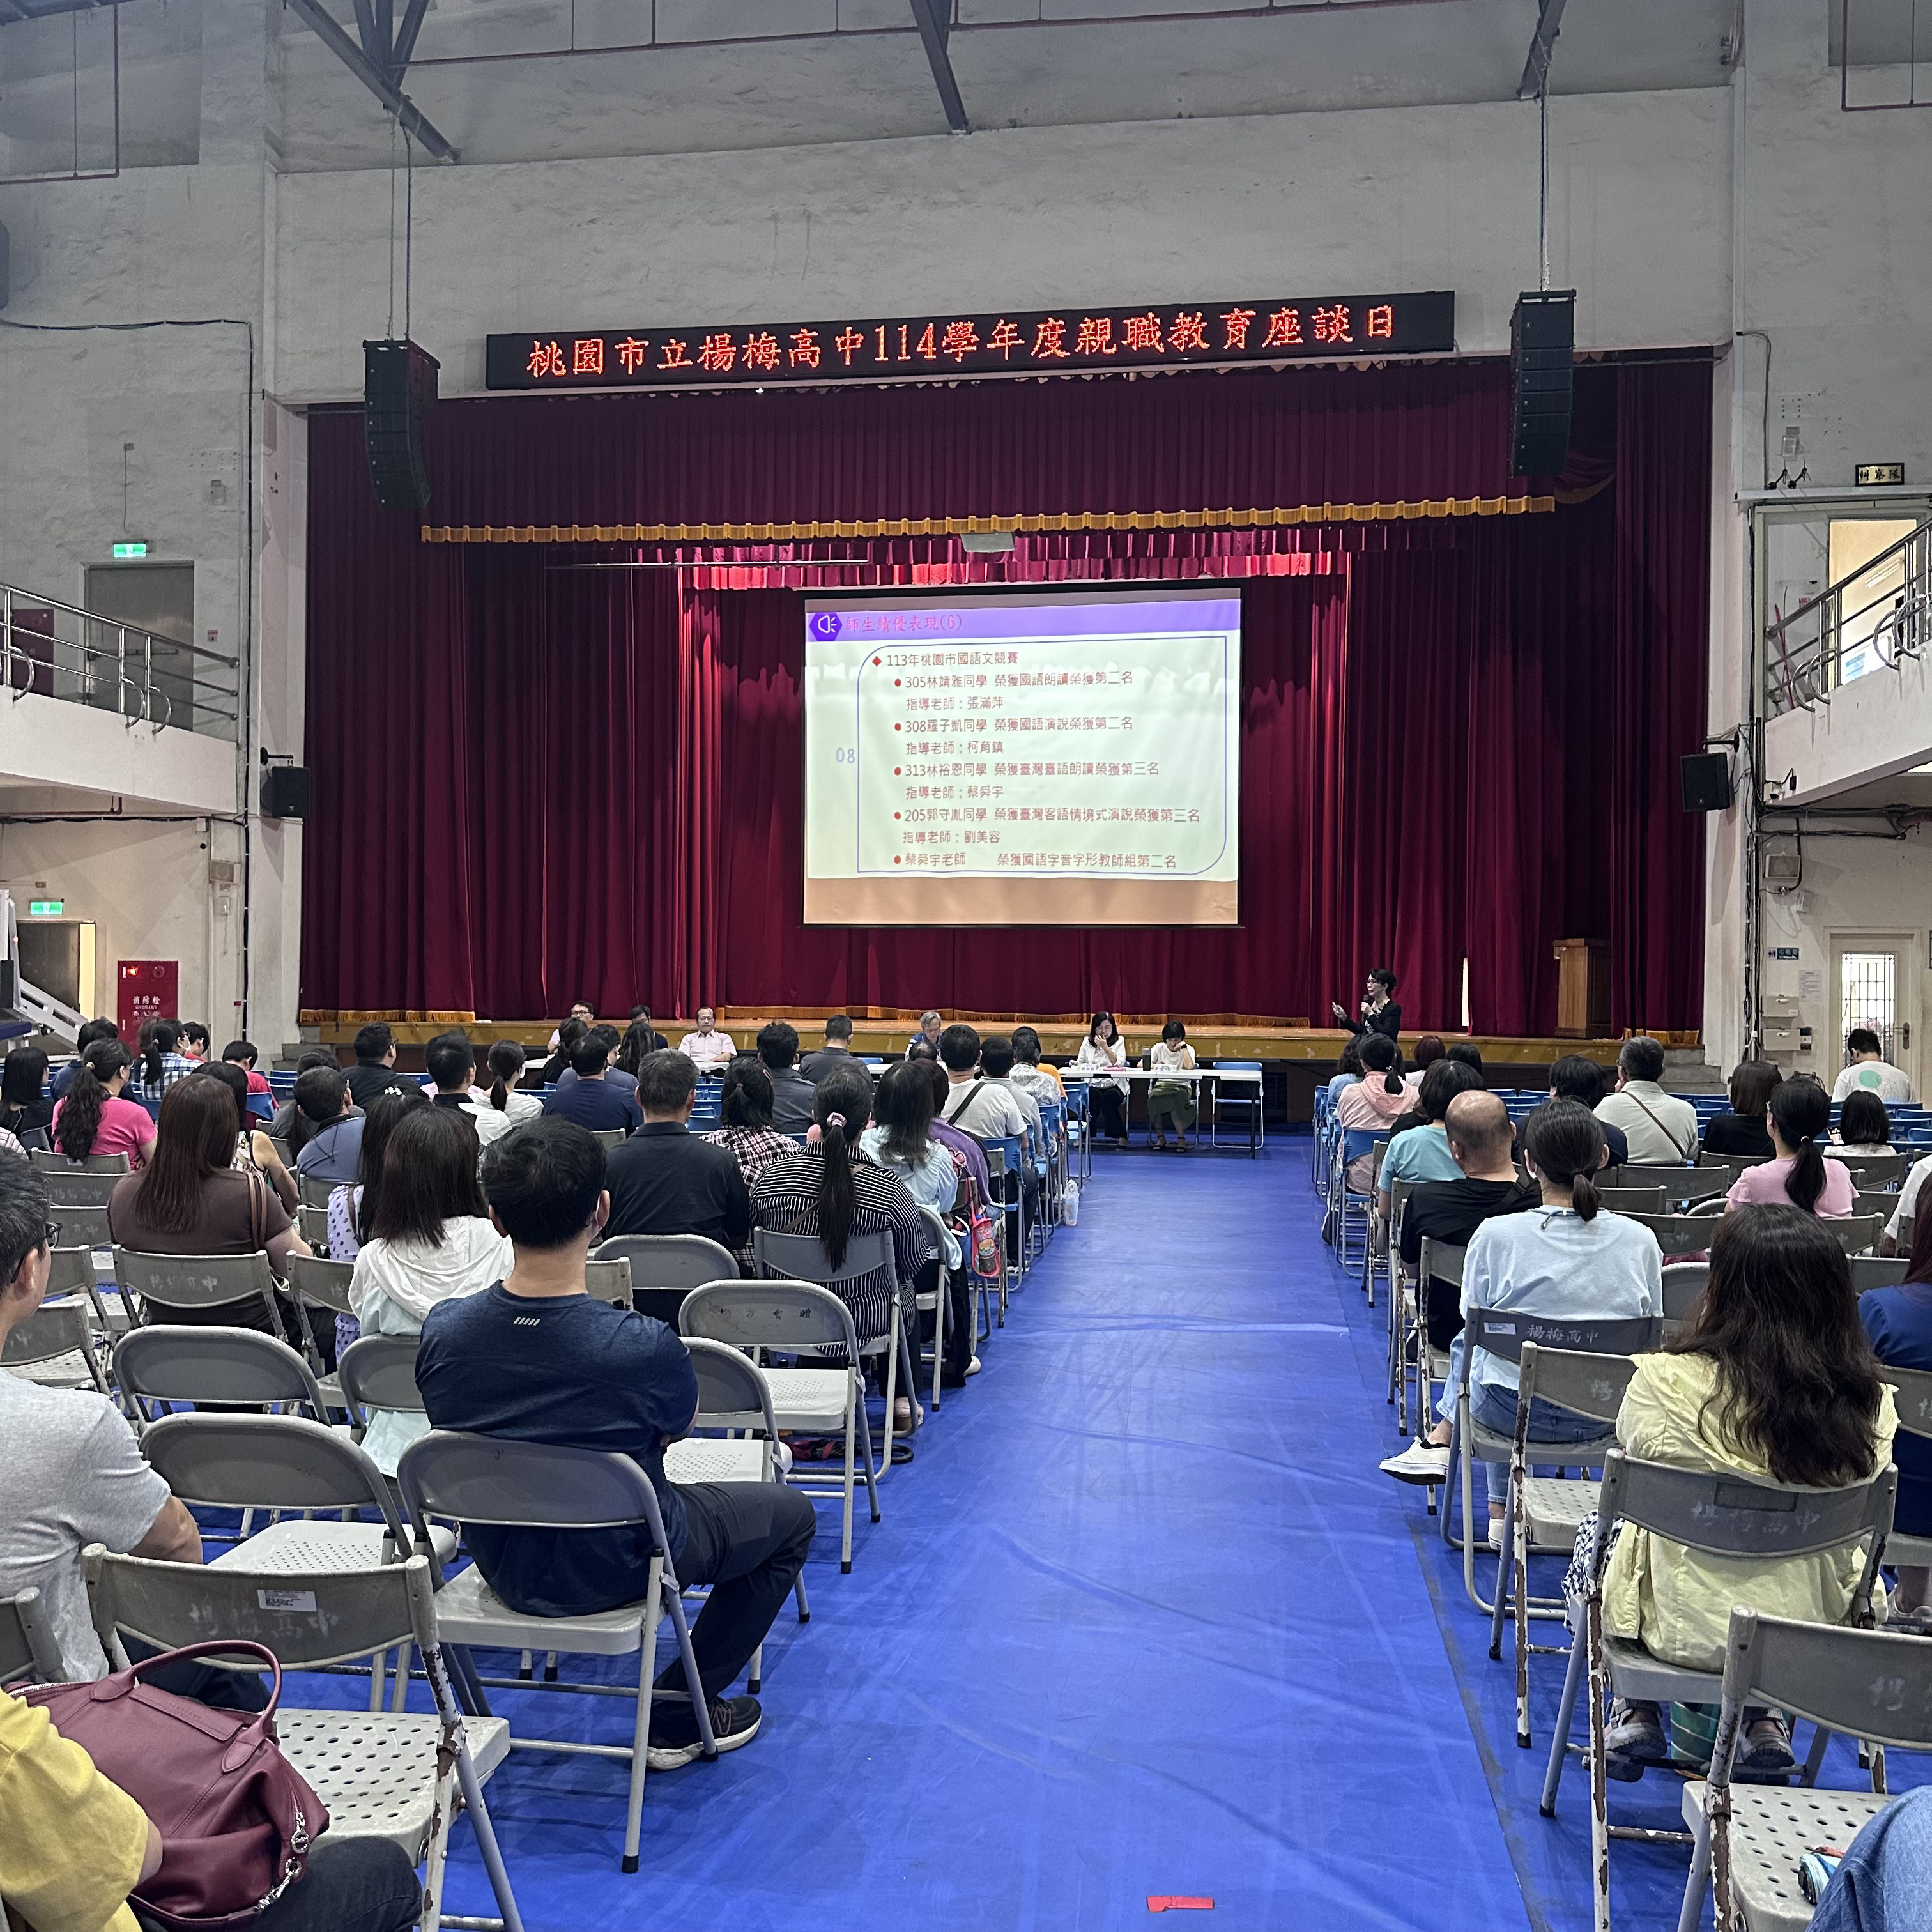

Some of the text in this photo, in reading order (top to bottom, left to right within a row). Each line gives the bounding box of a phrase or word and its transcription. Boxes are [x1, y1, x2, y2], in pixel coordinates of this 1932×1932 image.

[528, 305, 1393, 377] 桃園市立楊梅高中114學年度親職教育座談日
[887, 652, 1018, 666] 113年桃園市國語文競賽
[995, 671, 1132, 687] 榮獲國語朗讀榮獲第二名
[995, 716, 1132, 731] 榮獲國語演說榮獲第二名
[836, 748, 855, 763] 08
[995, 762, 1158, 776] 榮獲臺灣臺語朗讀榮獲第三名
[995, 808, 1199, 822] 榮獲臺灣客語情境式演說榮獲第三名
[998, 853, 1176, 868] 榮獲國語字音字形教師組第二名
[133, 995, 160, 1004] 消防栓
[1527, 1324, 1598, 1344] 楊梅高中
